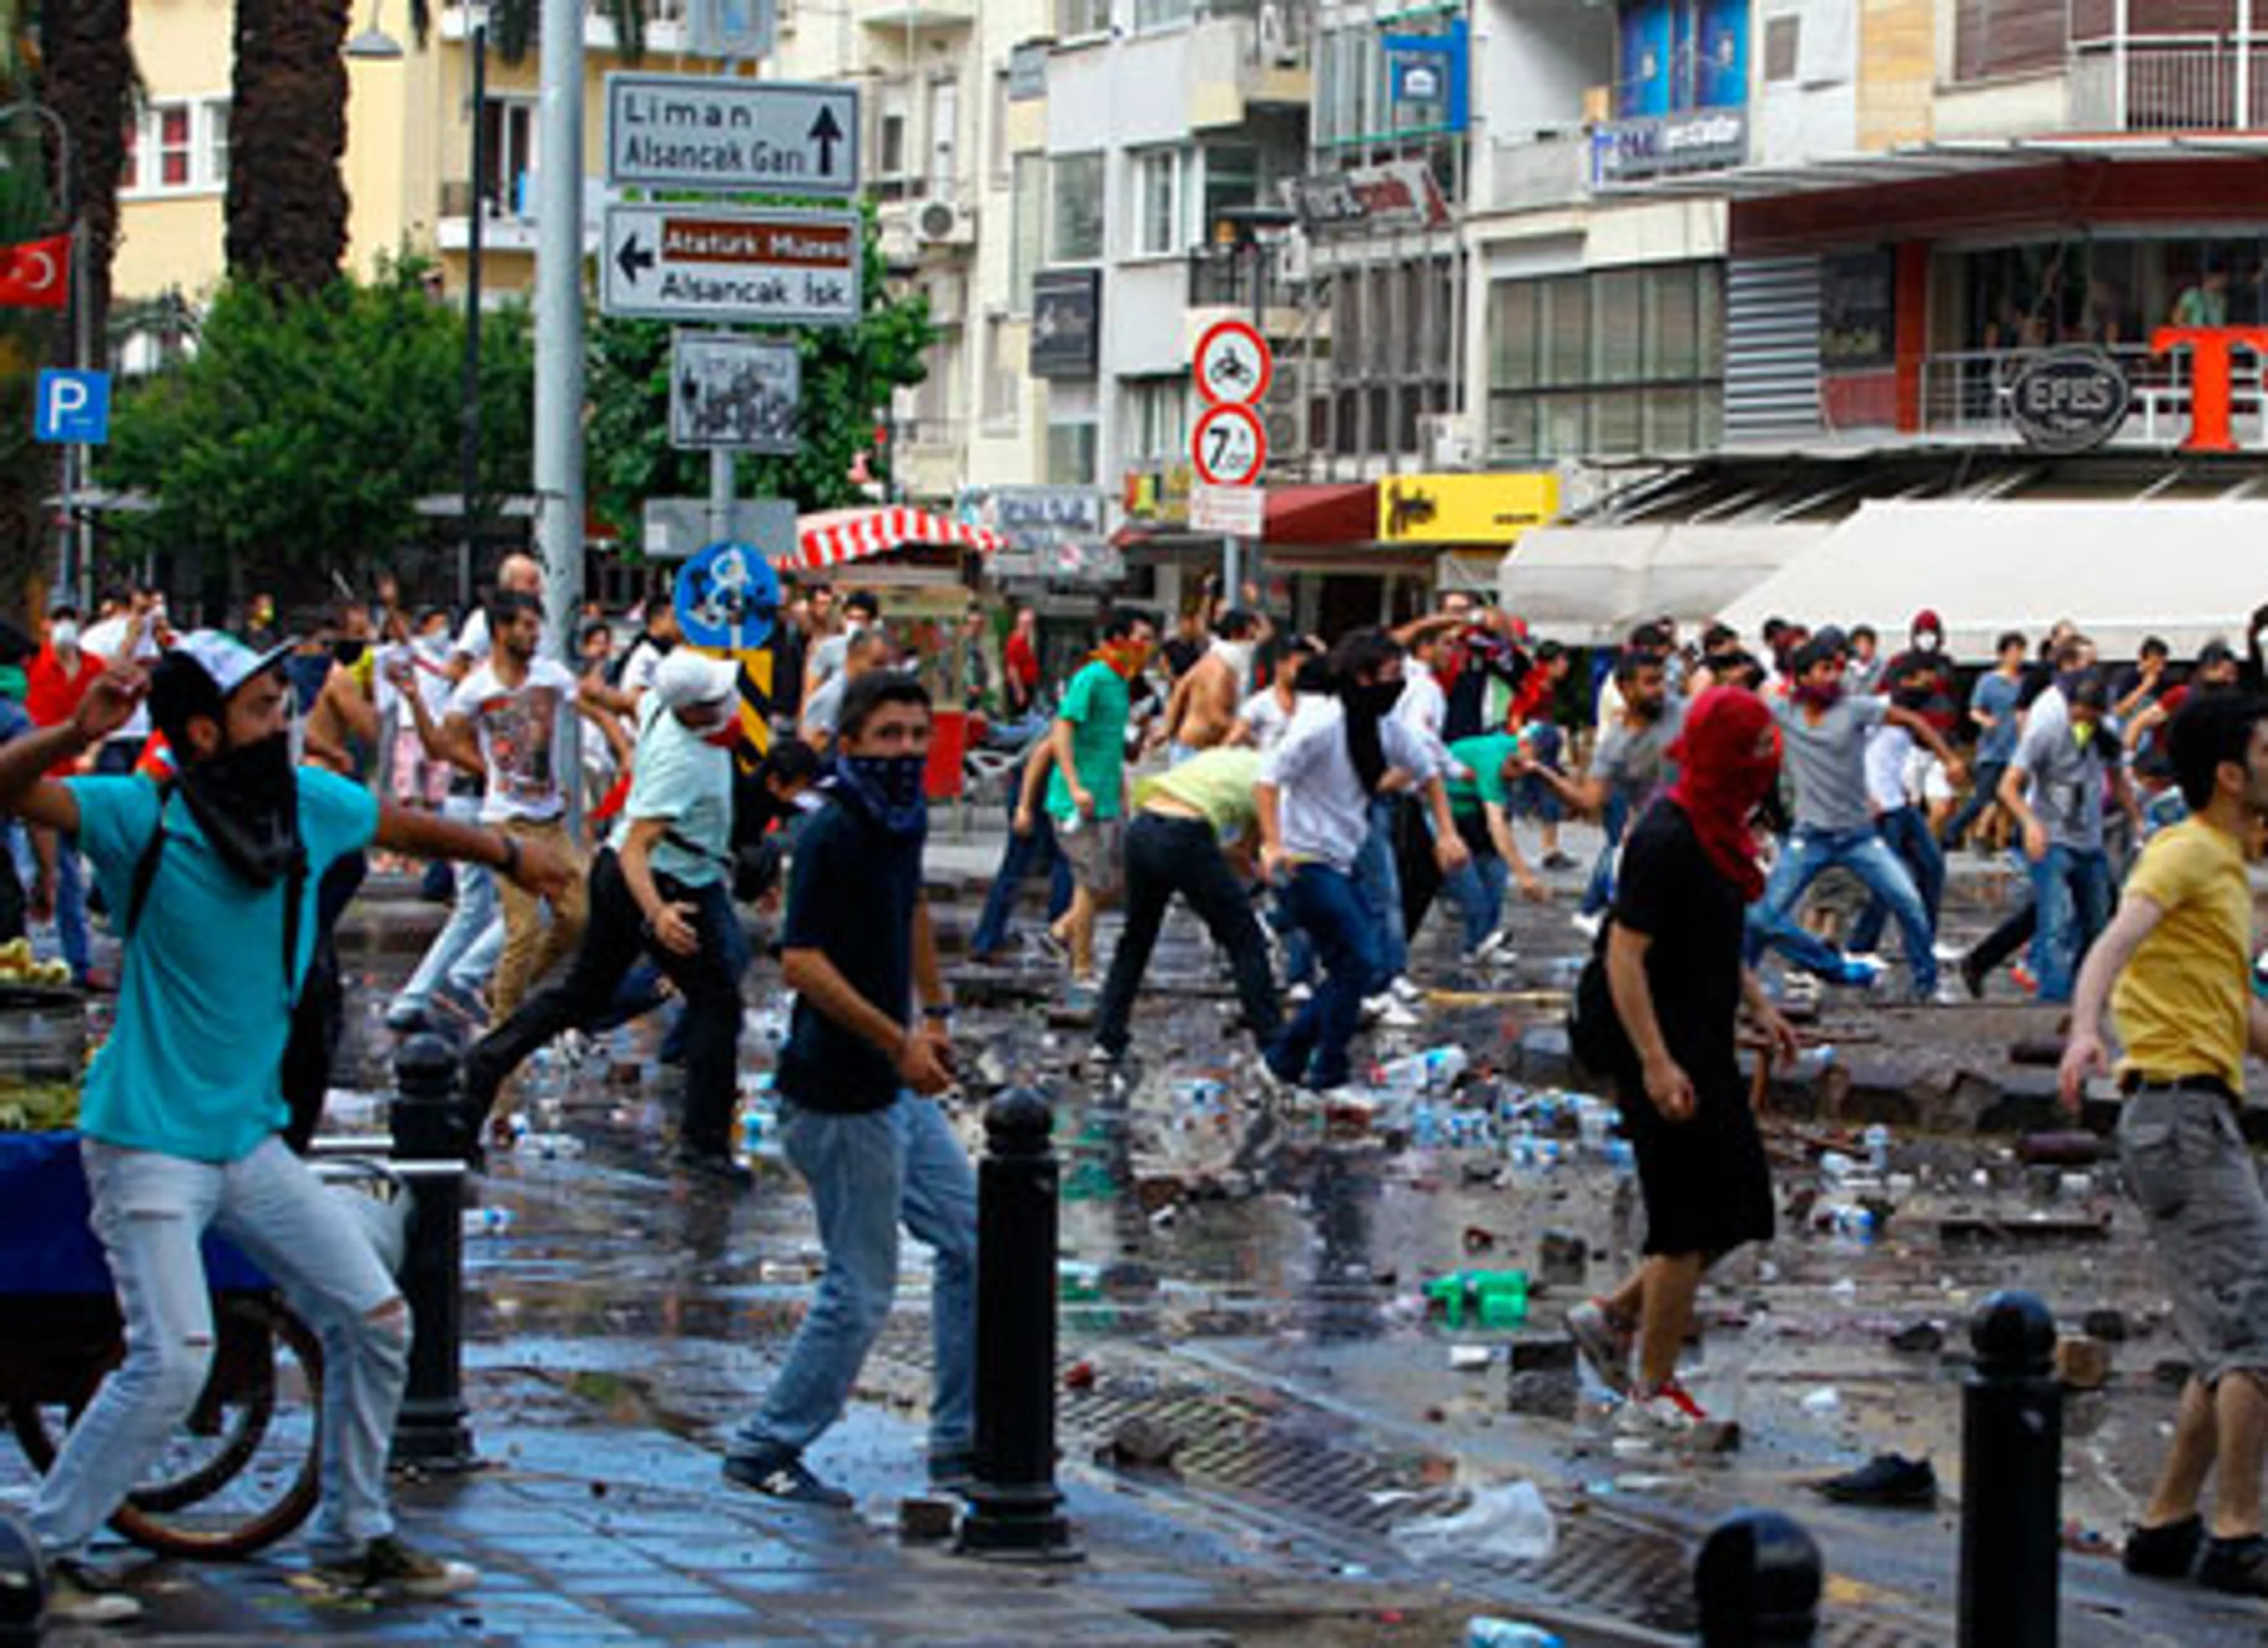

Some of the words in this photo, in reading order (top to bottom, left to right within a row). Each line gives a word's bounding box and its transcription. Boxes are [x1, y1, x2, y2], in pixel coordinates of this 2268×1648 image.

[624, 93, 753, 128] Liman
[624, 135, 742, 171] Alsancak
[660, 271, 790, 303] Alsancak
[48, 378, 87, 433] P
[2025, 373, 2111, 410] EFES
